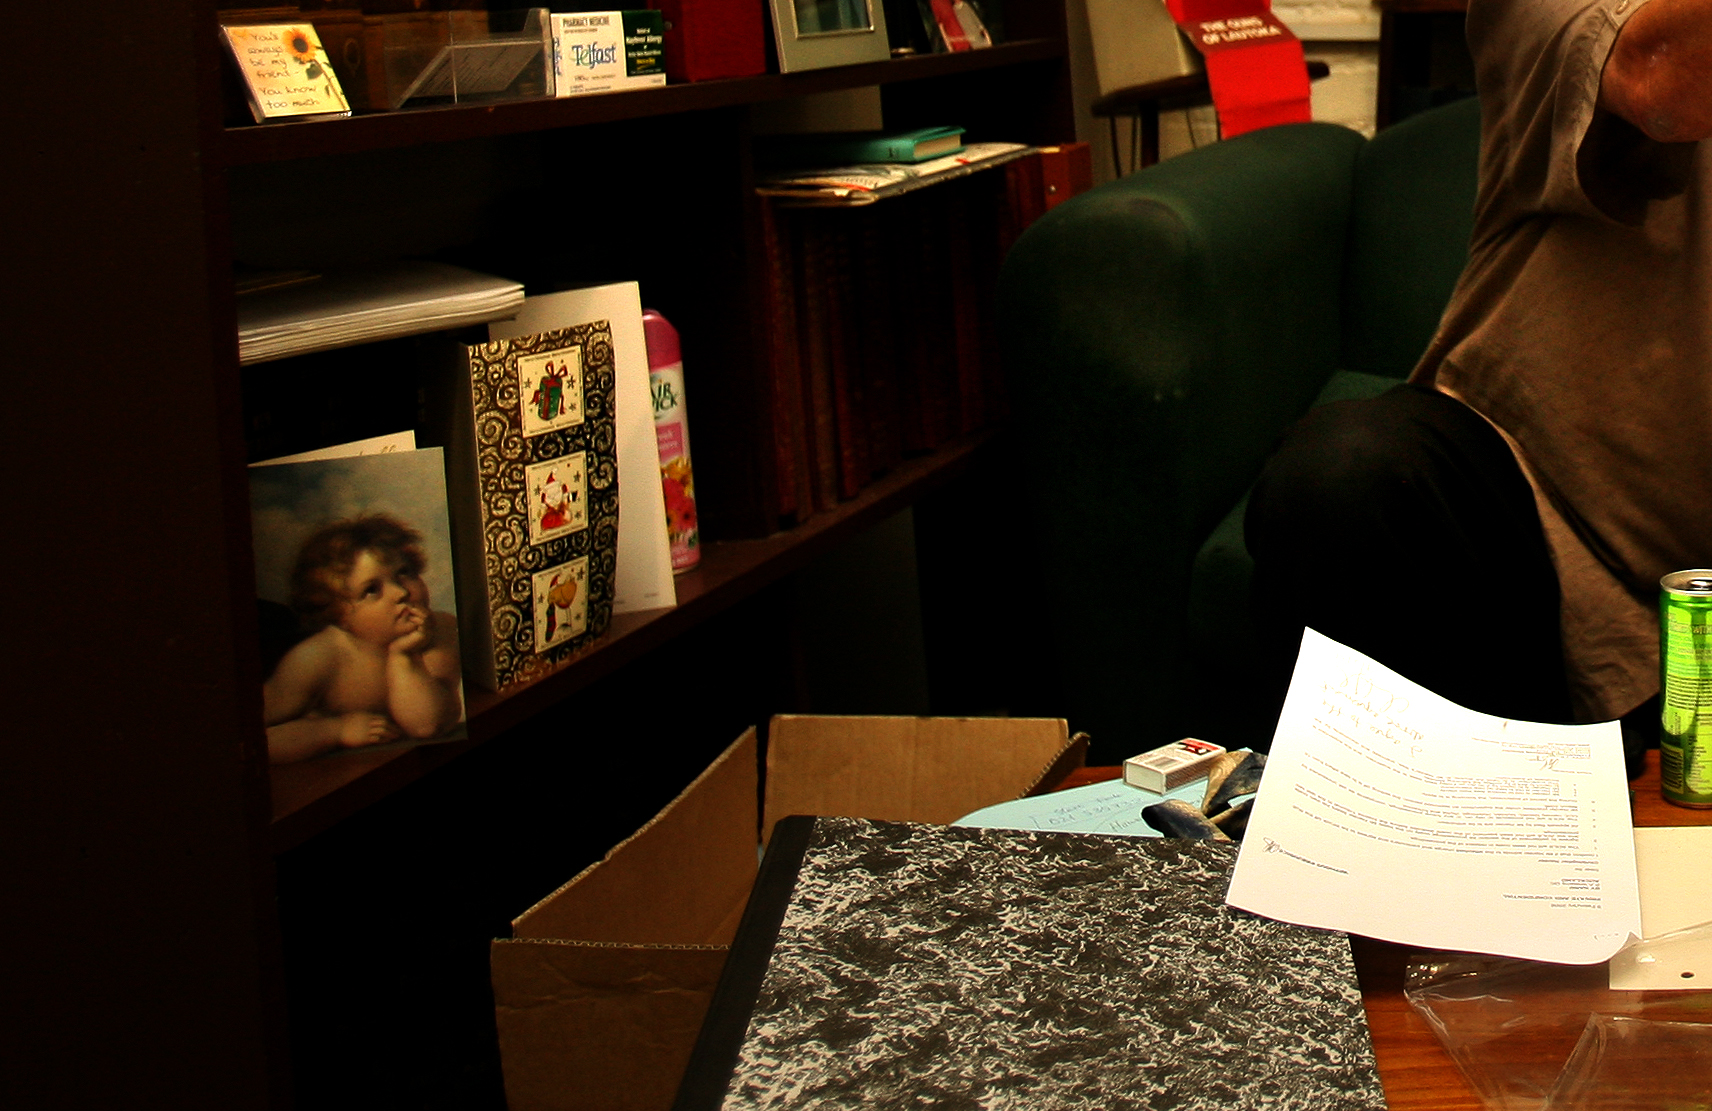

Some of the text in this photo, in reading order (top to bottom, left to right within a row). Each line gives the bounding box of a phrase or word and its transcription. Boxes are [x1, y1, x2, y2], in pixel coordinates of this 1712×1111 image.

[1200, 19, 1228, 33] THE
[1202, 32, 1220, 45] OF
[571, 42, 617, 69] Telfast
[249, 57, 288, 70] be my
[258, 85, 317, 97] You know
[265, 101, 288, 110] too
